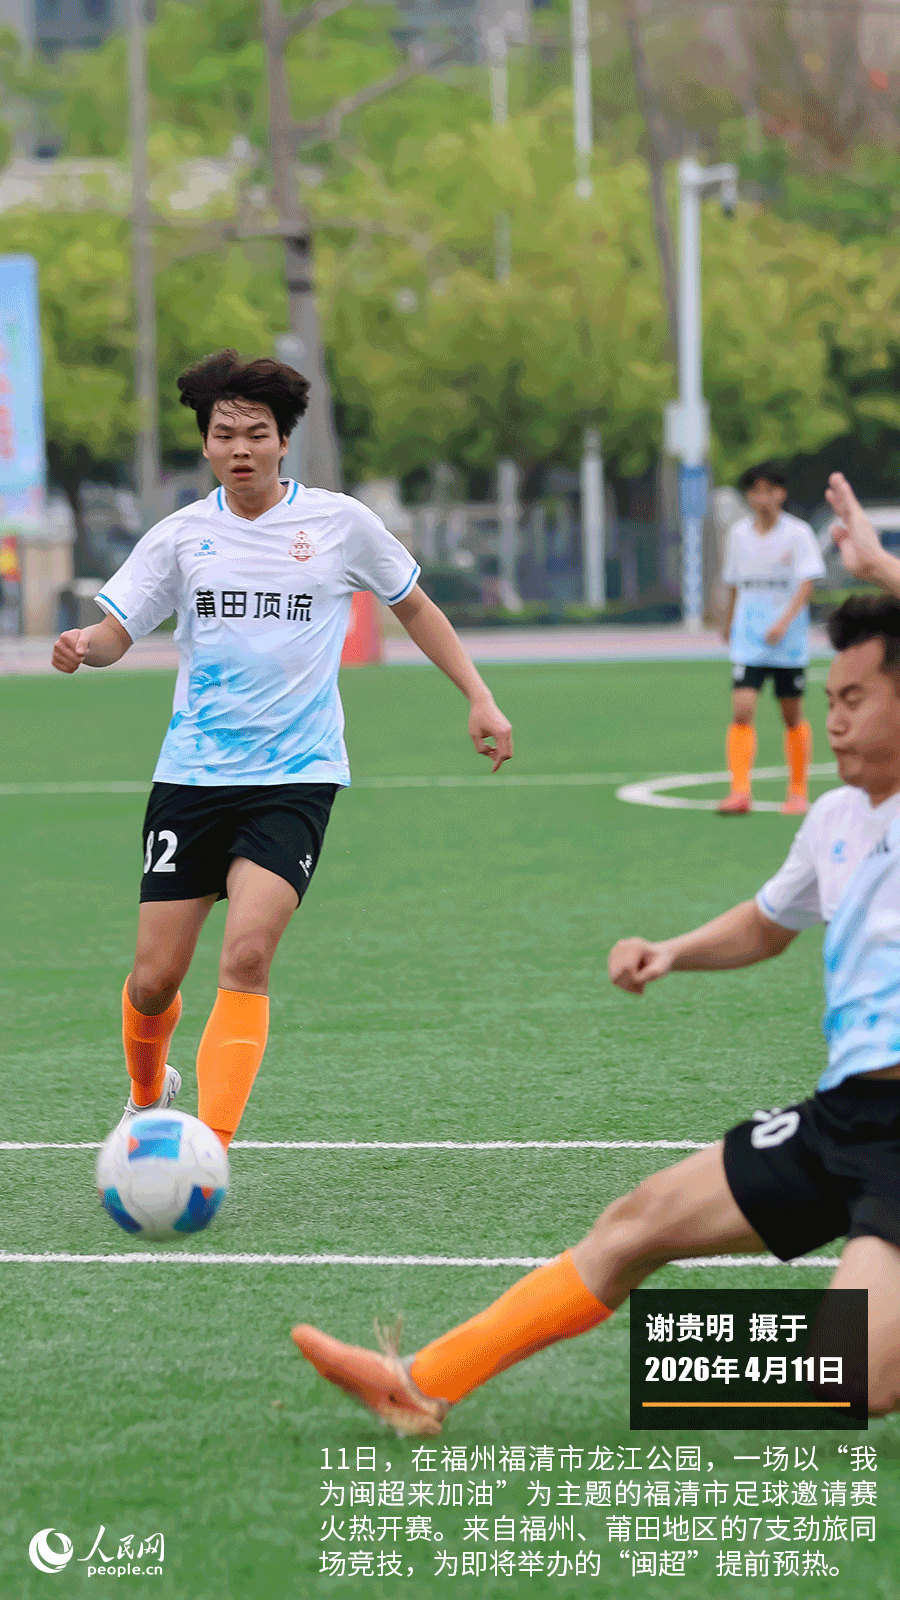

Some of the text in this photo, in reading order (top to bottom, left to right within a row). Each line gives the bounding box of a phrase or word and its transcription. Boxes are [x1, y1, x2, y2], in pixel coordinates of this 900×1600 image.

[196, 590, 313, 621] 莆田顶流
[751, 1107, 800, 1149] 0
